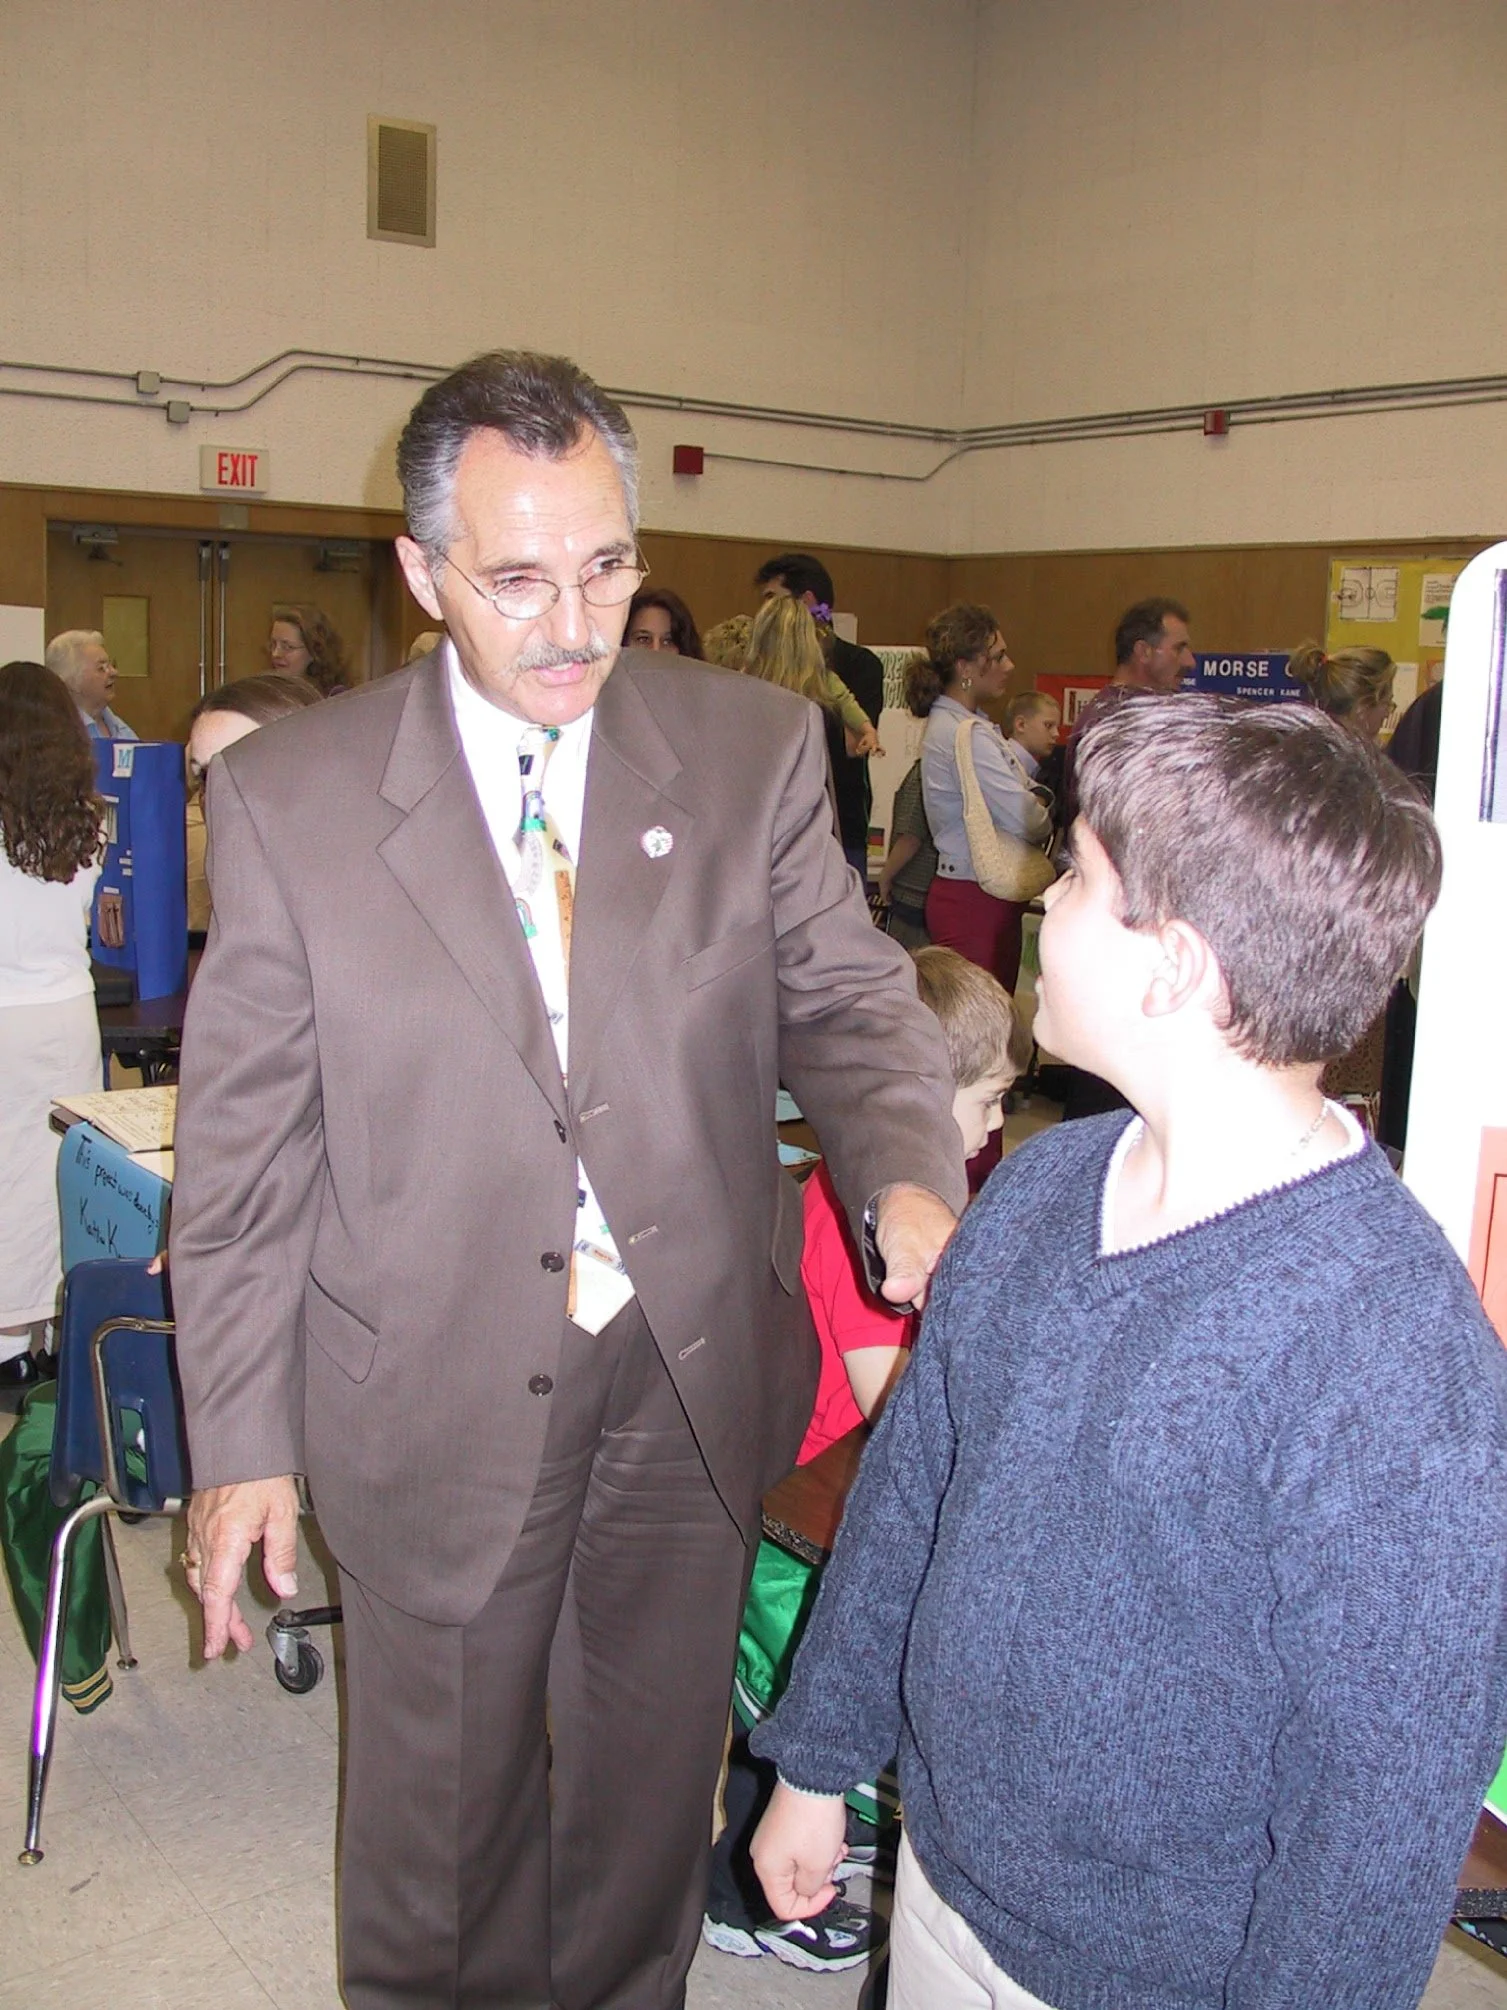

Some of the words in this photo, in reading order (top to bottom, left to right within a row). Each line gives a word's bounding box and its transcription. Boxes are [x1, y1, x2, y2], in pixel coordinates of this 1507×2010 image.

[218, 452, 258, 488] EXIT
[1203, 660, 1269, 677] MORSE
[1237, 687, 1275, 696] SPENCER
[1280, 688, 1300, 697] KANE
